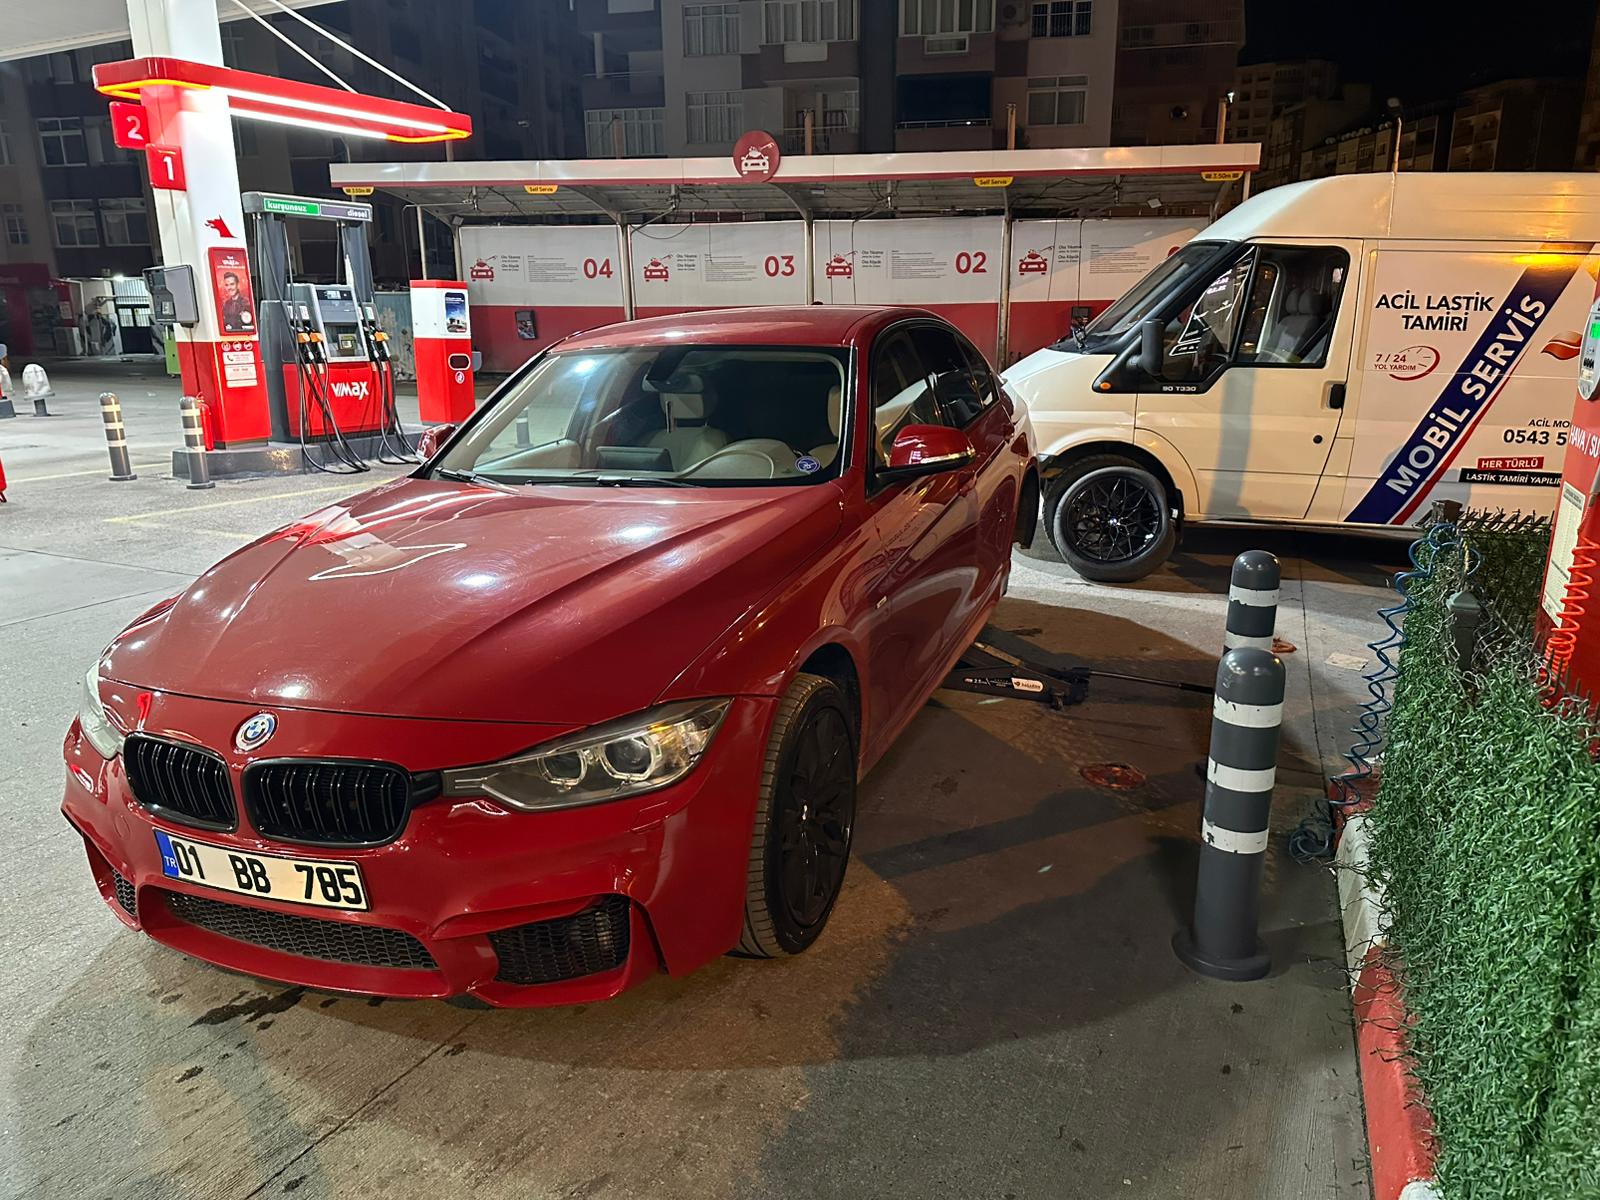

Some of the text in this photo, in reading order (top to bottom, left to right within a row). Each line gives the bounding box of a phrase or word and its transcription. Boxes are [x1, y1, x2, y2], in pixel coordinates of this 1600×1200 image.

[126, 115, 144, 140] 2
[163, 156, 175, 181] 1
[347, 209, 367, 218] diesel
[583, 258, 613, 279] 04
[764, 255, 795, 277] 03
[955, 251, 987, 274] 02
[1375, 289, 1495, 312] ACİL LASTİK
[1401, 311, 1469, 331] TAMİRİ
[1393, 354, 1407, 363] 24
[1385, 294, 1546, 495] MOBİL SERVİS
[1528, 417, 1571, 428] ACİL MO
[1503, 429, 1568, 446] 0543 5
[1568, 424, 1586, 451] HAVA
[1481, 457, 1539, 468] HER TÜRLÜ
[1466, 471, 1496, 481] LASTİK
[1498, 473, 1529, 483] TAMİRİ
[164, 855, 177, 868] TR
[171, 840, 363, 905] 01 BB 785
